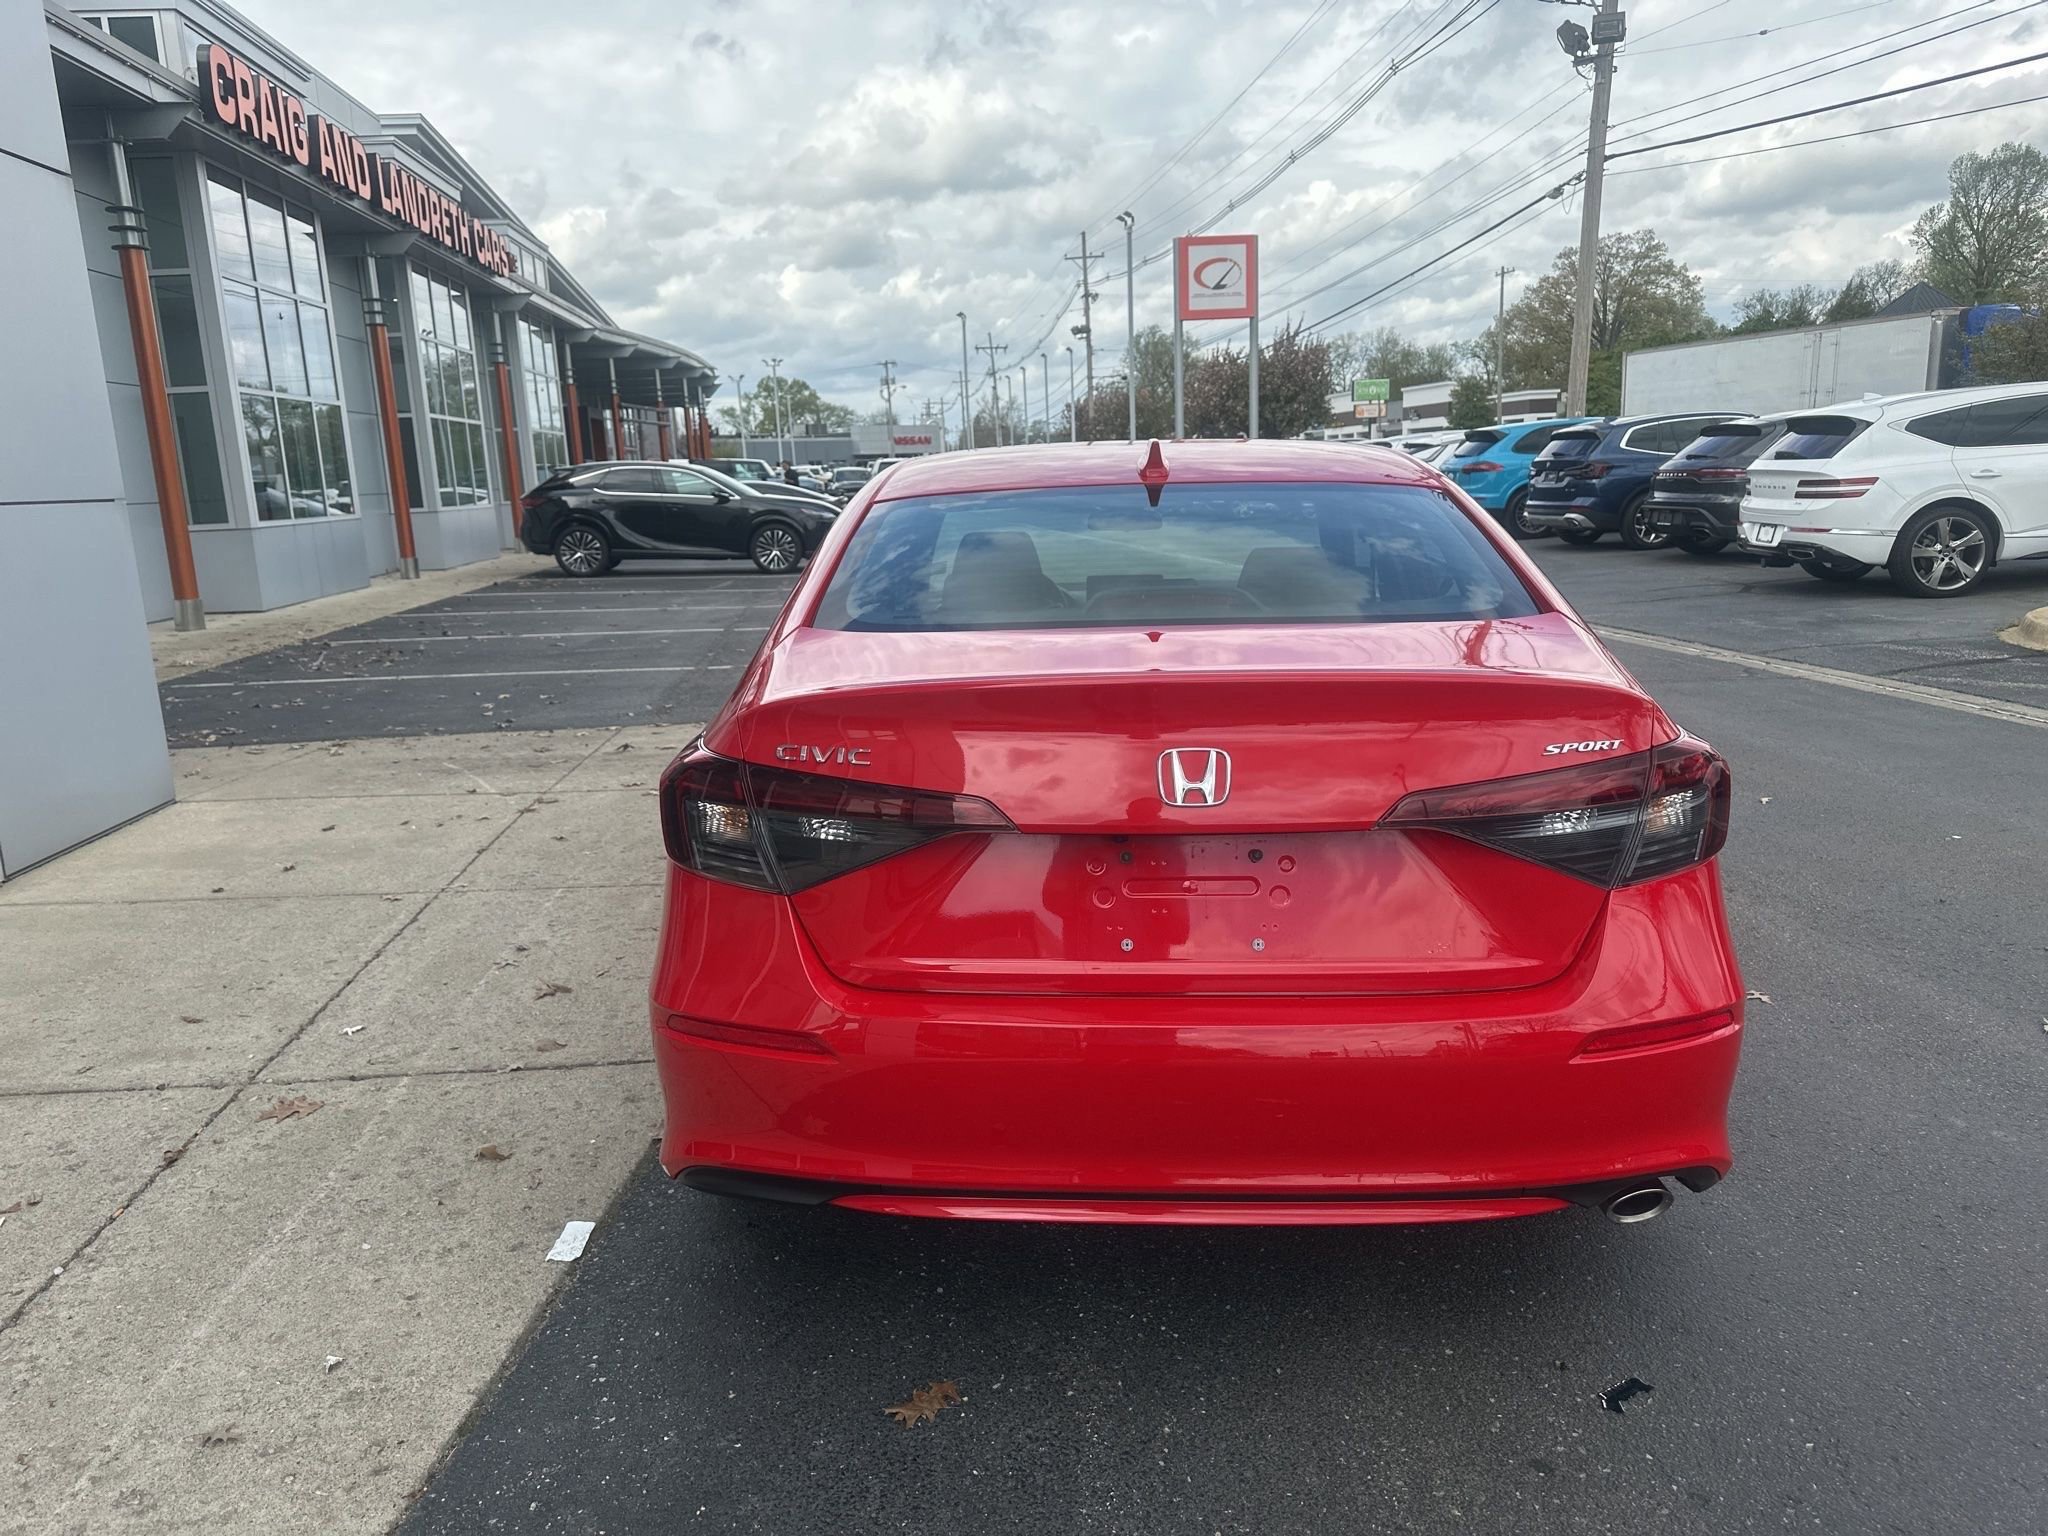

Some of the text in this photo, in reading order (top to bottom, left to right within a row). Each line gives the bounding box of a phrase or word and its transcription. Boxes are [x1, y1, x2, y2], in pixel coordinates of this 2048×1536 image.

[209, 43, 509, 278] CRAIG AND LANDRETH CARS
[776, 744, 871, 766] CIVIC
[1542, 739, 1624, 756] SPORT
